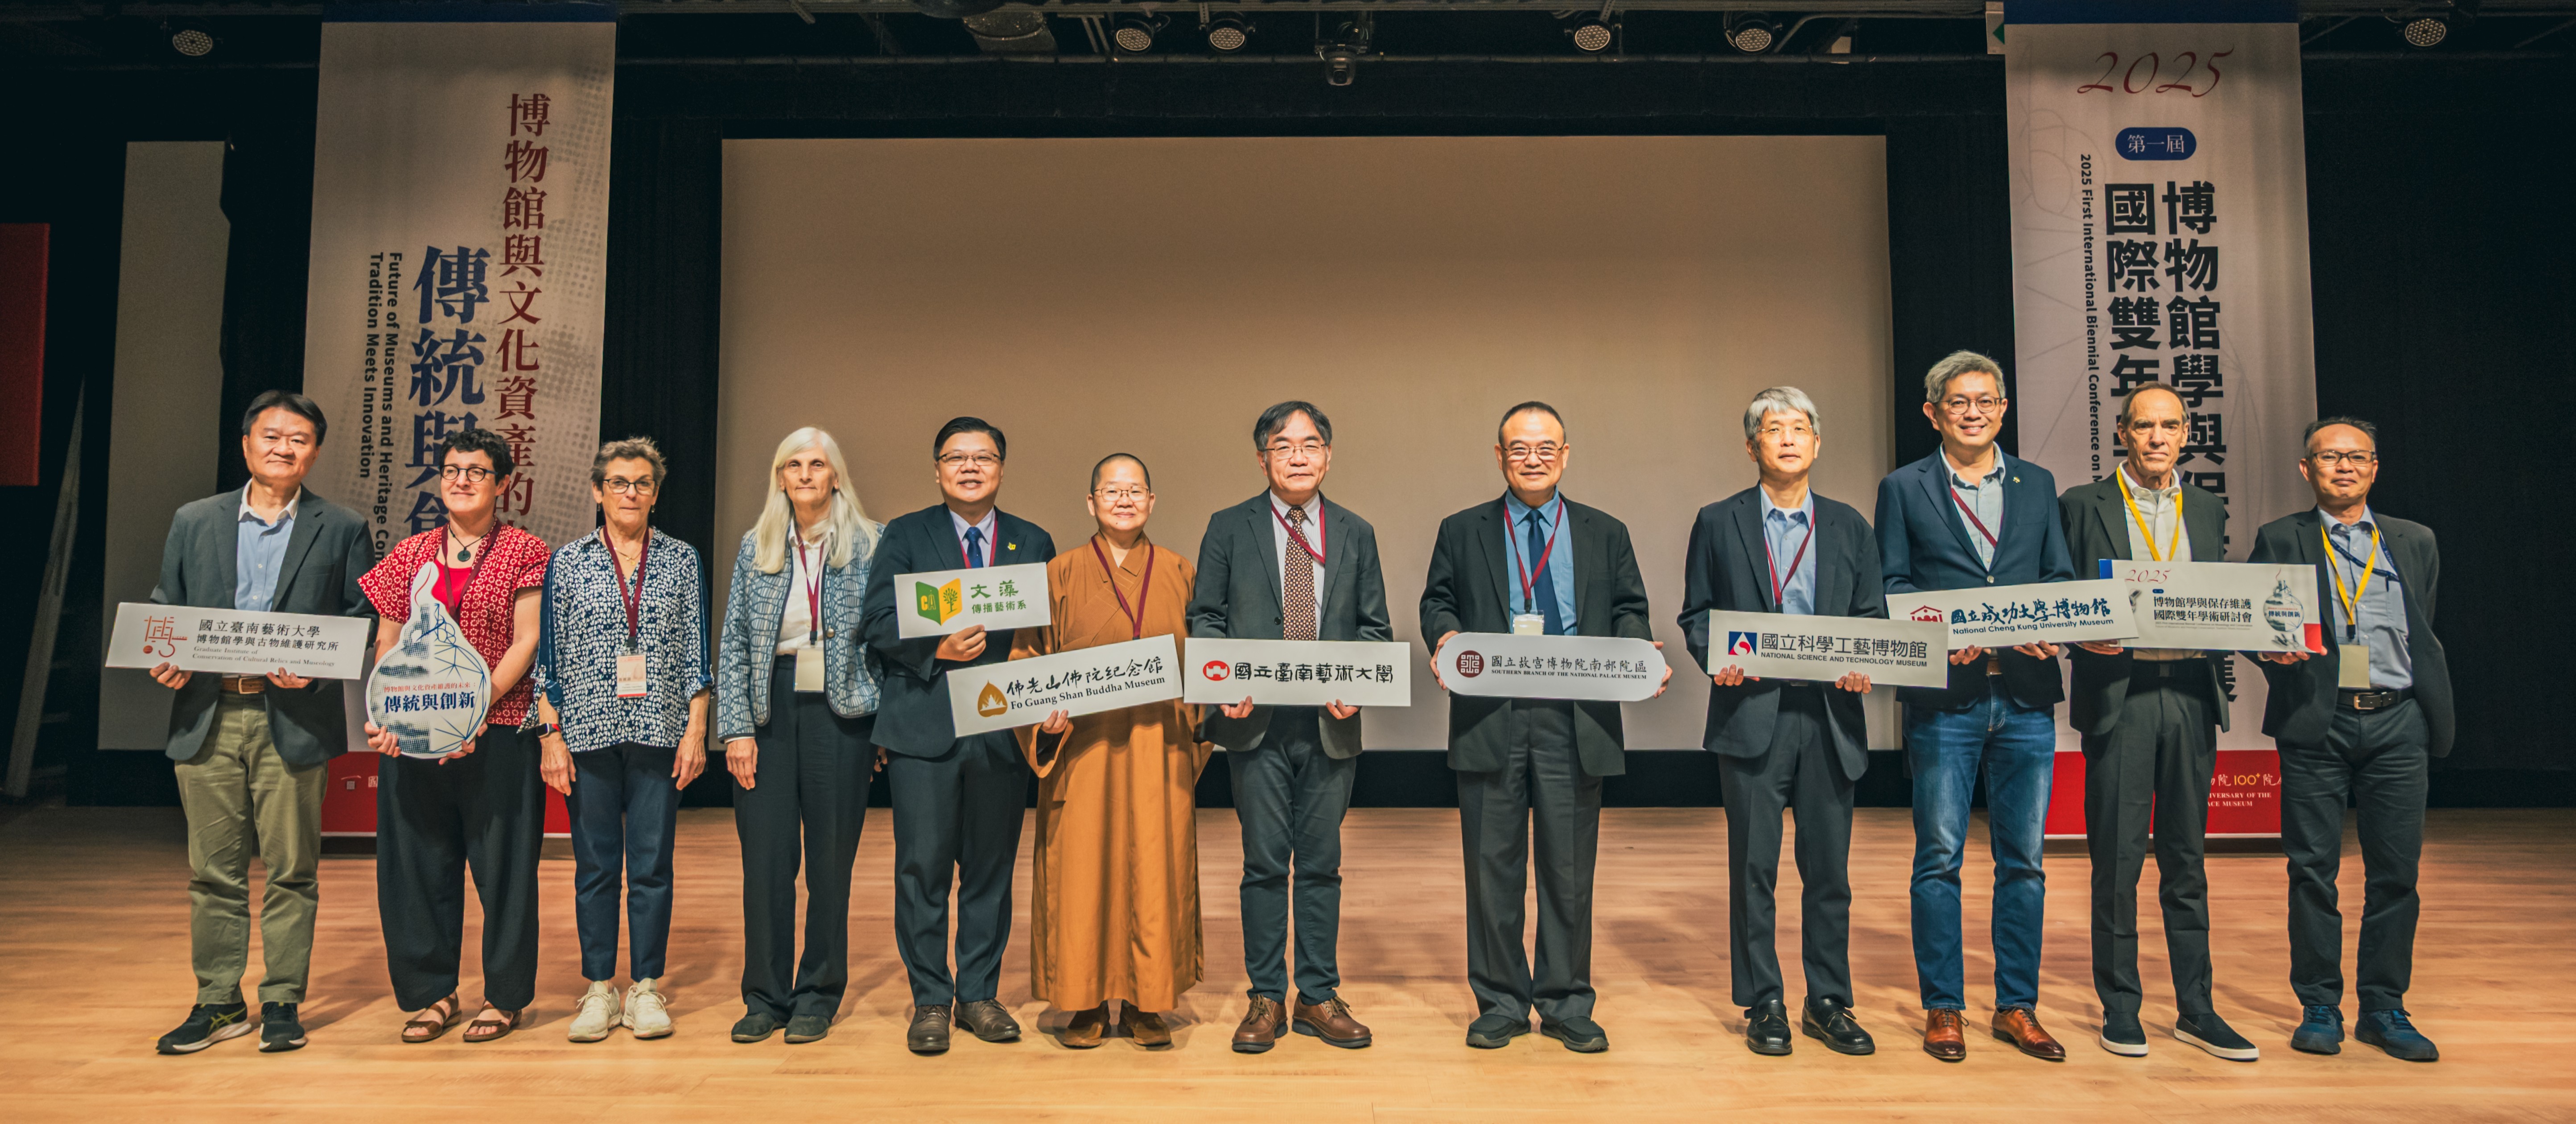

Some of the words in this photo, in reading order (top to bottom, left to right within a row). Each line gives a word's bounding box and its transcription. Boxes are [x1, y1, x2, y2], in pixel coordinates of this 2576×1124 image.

[2077, 46, 2234, 98] 2025
[2127, 135, 2184, 153] 第一屆
[2081, 154, 2092, 185] 2025
[2082, 190, 2094, 219] First
[387, 252, 402, 307] Future
[2083, 223, 2097, 312] International
[367, 252, 383, 329] Tradition
[386, 312, 400, 329] of
[494, 93, 552, 531] 博物館與文化資產的
[2105, 183, 2161, 457] 國際雙年
[2086, 315, 2099, 370] Biennial
[364, 334, 379, 382] Meets
[382, 333, 398, 411] Museums
[2089, 374, 2100, 450] Conference
[360, 387, 377, 478] Innovation
[381, 416, 394, 446] and
[2091, 455, 2100, 471] on
[374, 452, 392, 524] Heritage
[2125, 568, 2171, 583] 2025
[971, 579, 1019, 599] 文藻
[972, 599, 1026, 614] 傳播藝術系
[1951, 598, 2111, 624] 國立成功大學博物館
[2154, 596, 2252, 609] 博物館學與保存維護
[199, 619, 320, 638] 國立臺南藝術大學
[1953, 626, 1986, 634] National
[1988, 624, 2015, 632] Cheng
[2040, 620, 2077, 629] University
[2080, 618, 2114, 626] Museum
[2154, 609, 2252, 623] 國際雙年學術研討會
[196, 634, 339, 652] 博物館學與古物維護研究所
[1761, 633, 1927, 659] 國立科學工藝博物館
[1492, 655, 1647, 673] 國立故宮博物院南部院區
[1761, 652, 1795, 660] NATIONAL
[1846, 657, 1894, 665] TECHNOLOGY
[1235, 662, 1393, 683] 國立臺南藝術大學
[384, 691, 475, 713] 傳統與創新
[1010, 701, 1022, 710] Fo
[1025, 696, 1058, 707] Guang
[1059, 691, 1084, 701] Shan
[1086, 684, 1122, 696] Buddha
[1125, 677, 1165, 690] Museum
